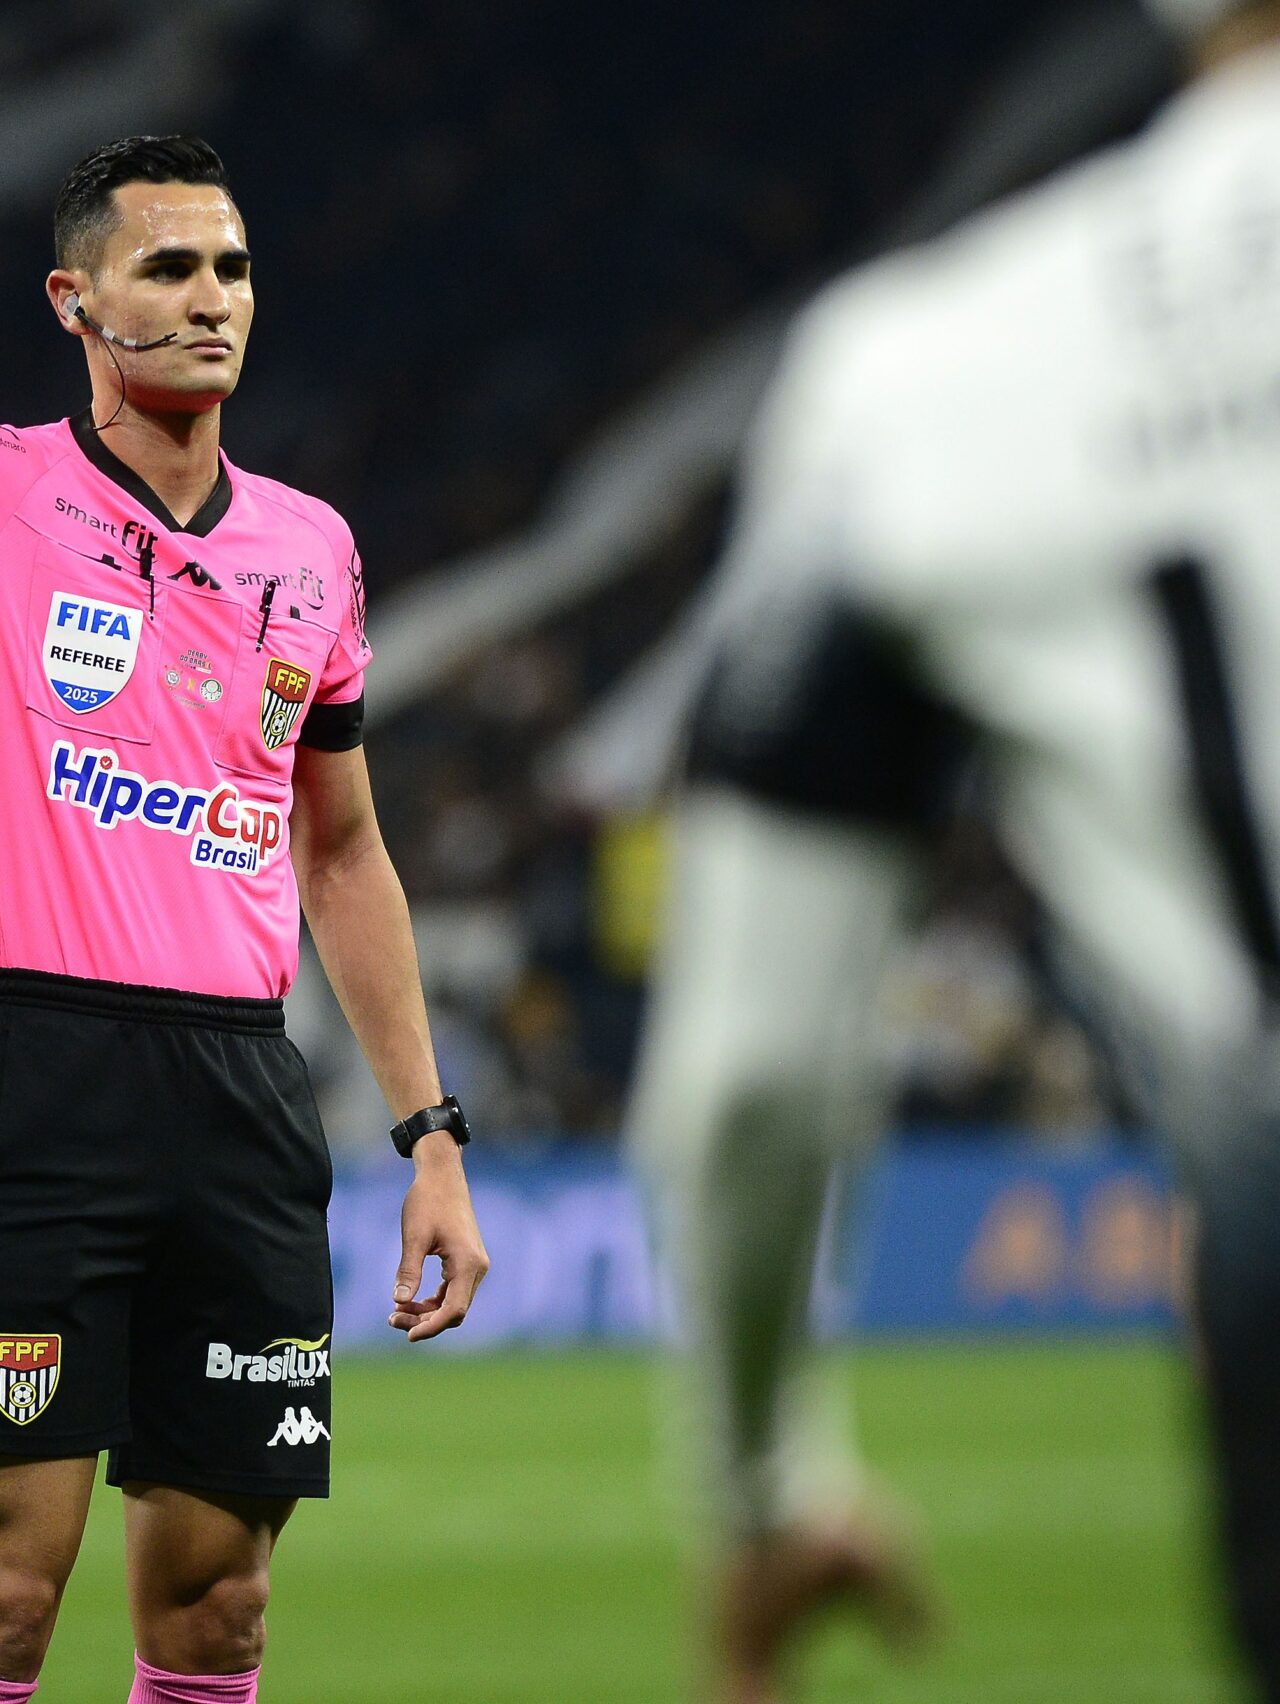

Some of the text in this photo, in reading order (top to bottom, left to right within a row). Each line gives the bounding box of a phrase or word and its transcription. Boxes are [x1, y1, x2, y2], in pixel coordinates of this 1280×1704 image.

[54, 497, 159, 559] smart fit
[56, 601, 131, 641] FIFA
[49, 645, 126, 673] REFEREE
[63, 686, 98, 704] 2025
[274, 668, 307, 695] FPF
[52, 747, 280, 860] HiperCap
[195, 838, 258, 872] Brasil
[205, 1342, 332, 1382] Brasilux
[286, 1378, 316, 1388] TINTAS
